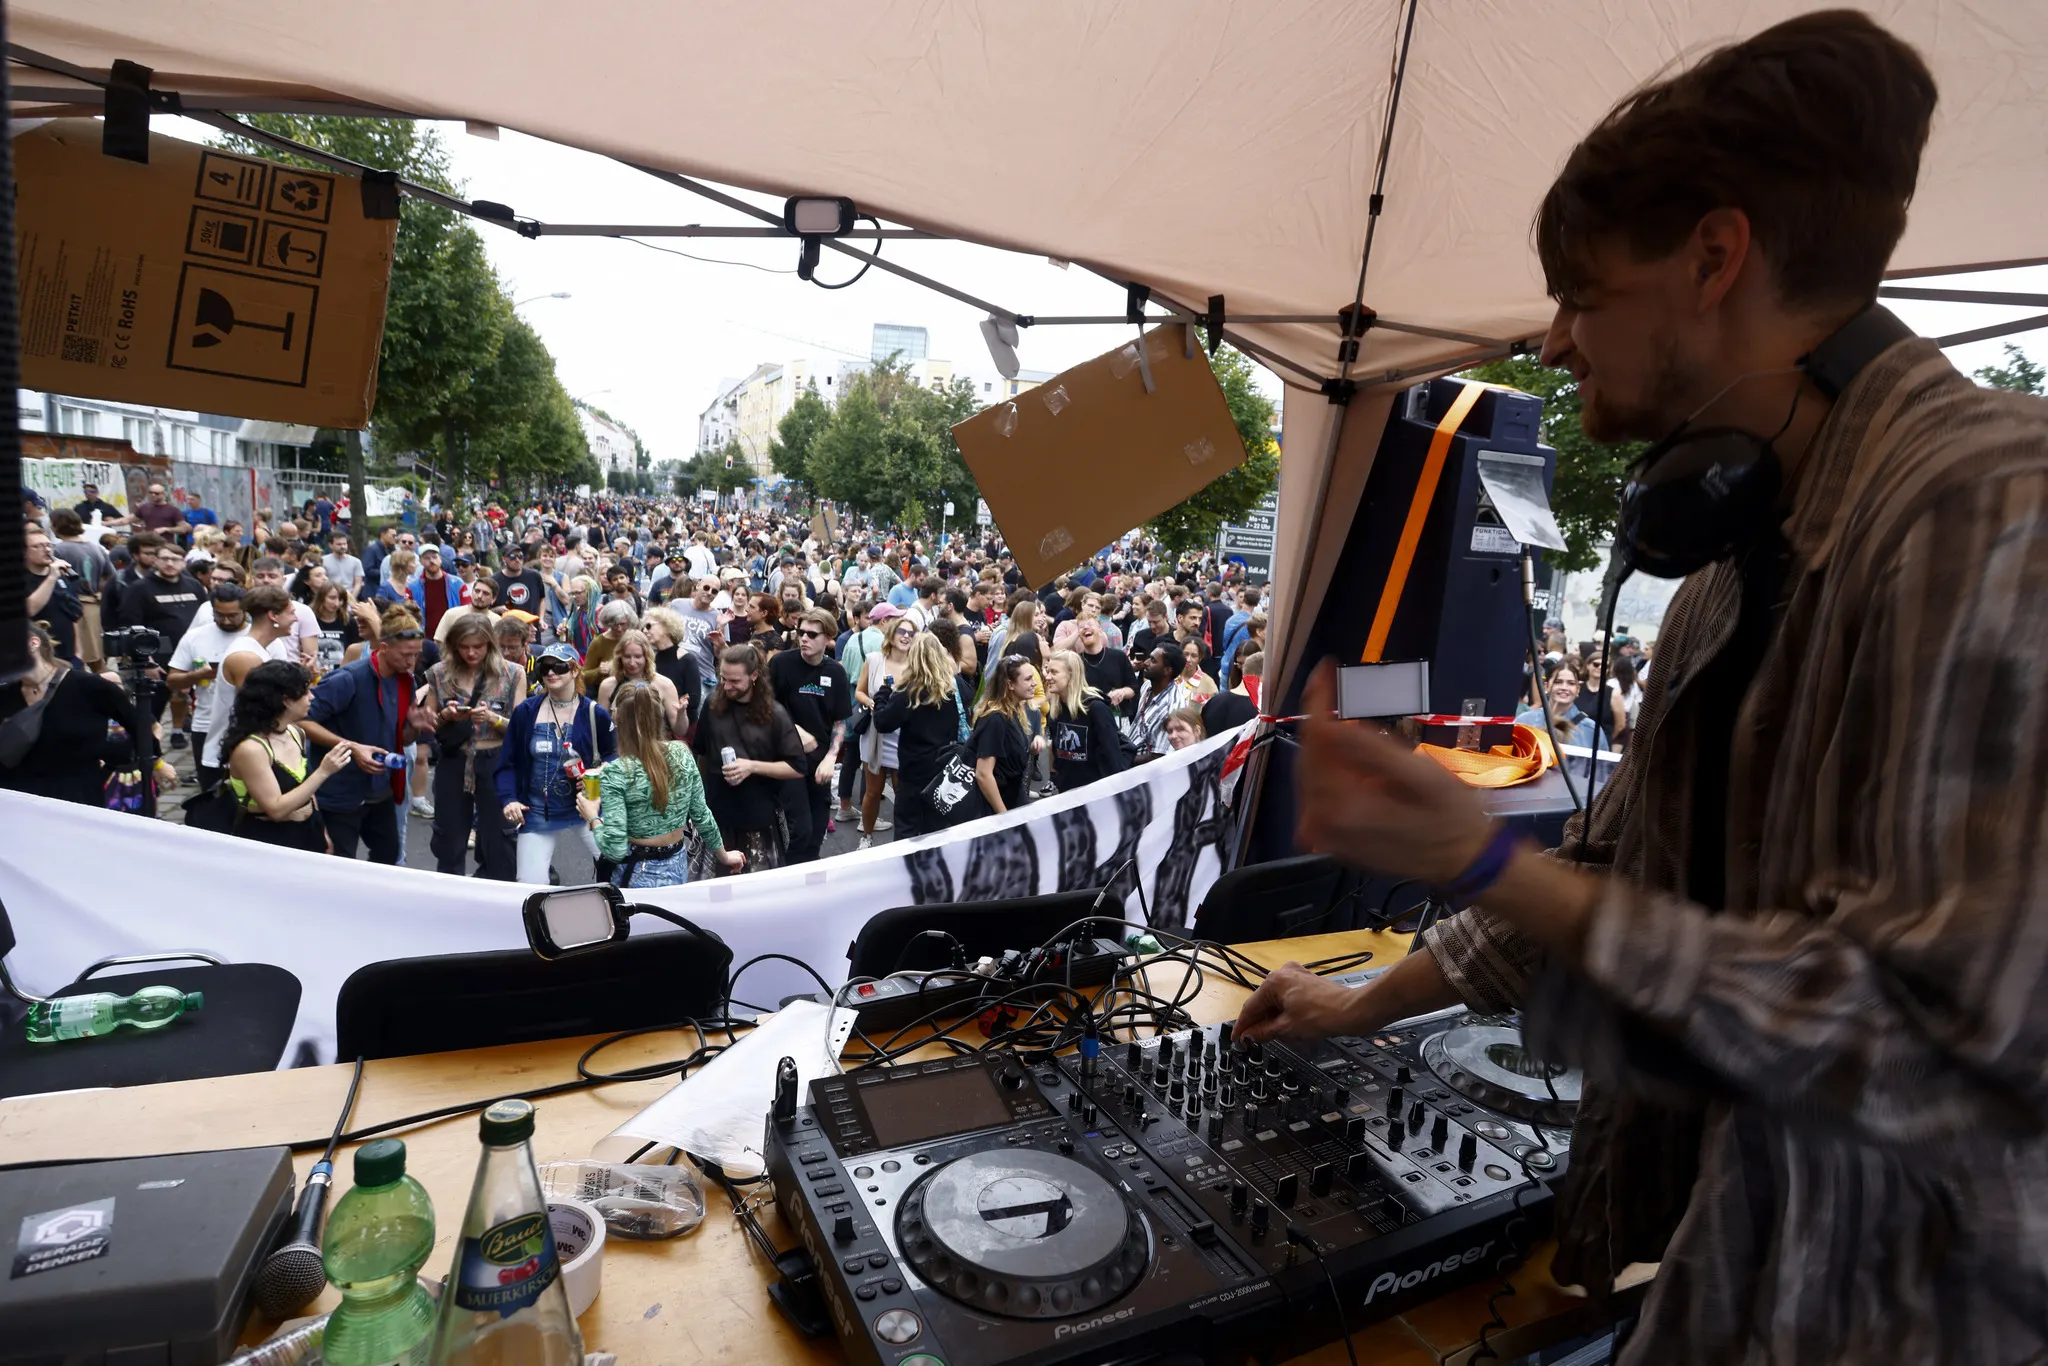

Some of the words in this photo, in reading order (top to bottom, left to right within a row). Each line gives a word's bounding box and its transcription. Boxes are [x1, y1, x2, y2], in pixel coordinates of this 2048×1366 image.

[208, 170, 235, 187] 4
[66, 293, 83, 333] PETKIT
[117, 290, 138, 329] RoHS
[43, 463, 77, 489] HEUTE
[1248, 566, 1267, 575] lidl.de
[486, 1219, 544, 1255] Bauer
[25, 1246, 103, 1273] DENKEN
[789, 1190, 853, 1337] Pioneer
[1363, 1239, 1496, 1306] Pioneer
[1054, 1306, 1136, 1339] Pioneer
